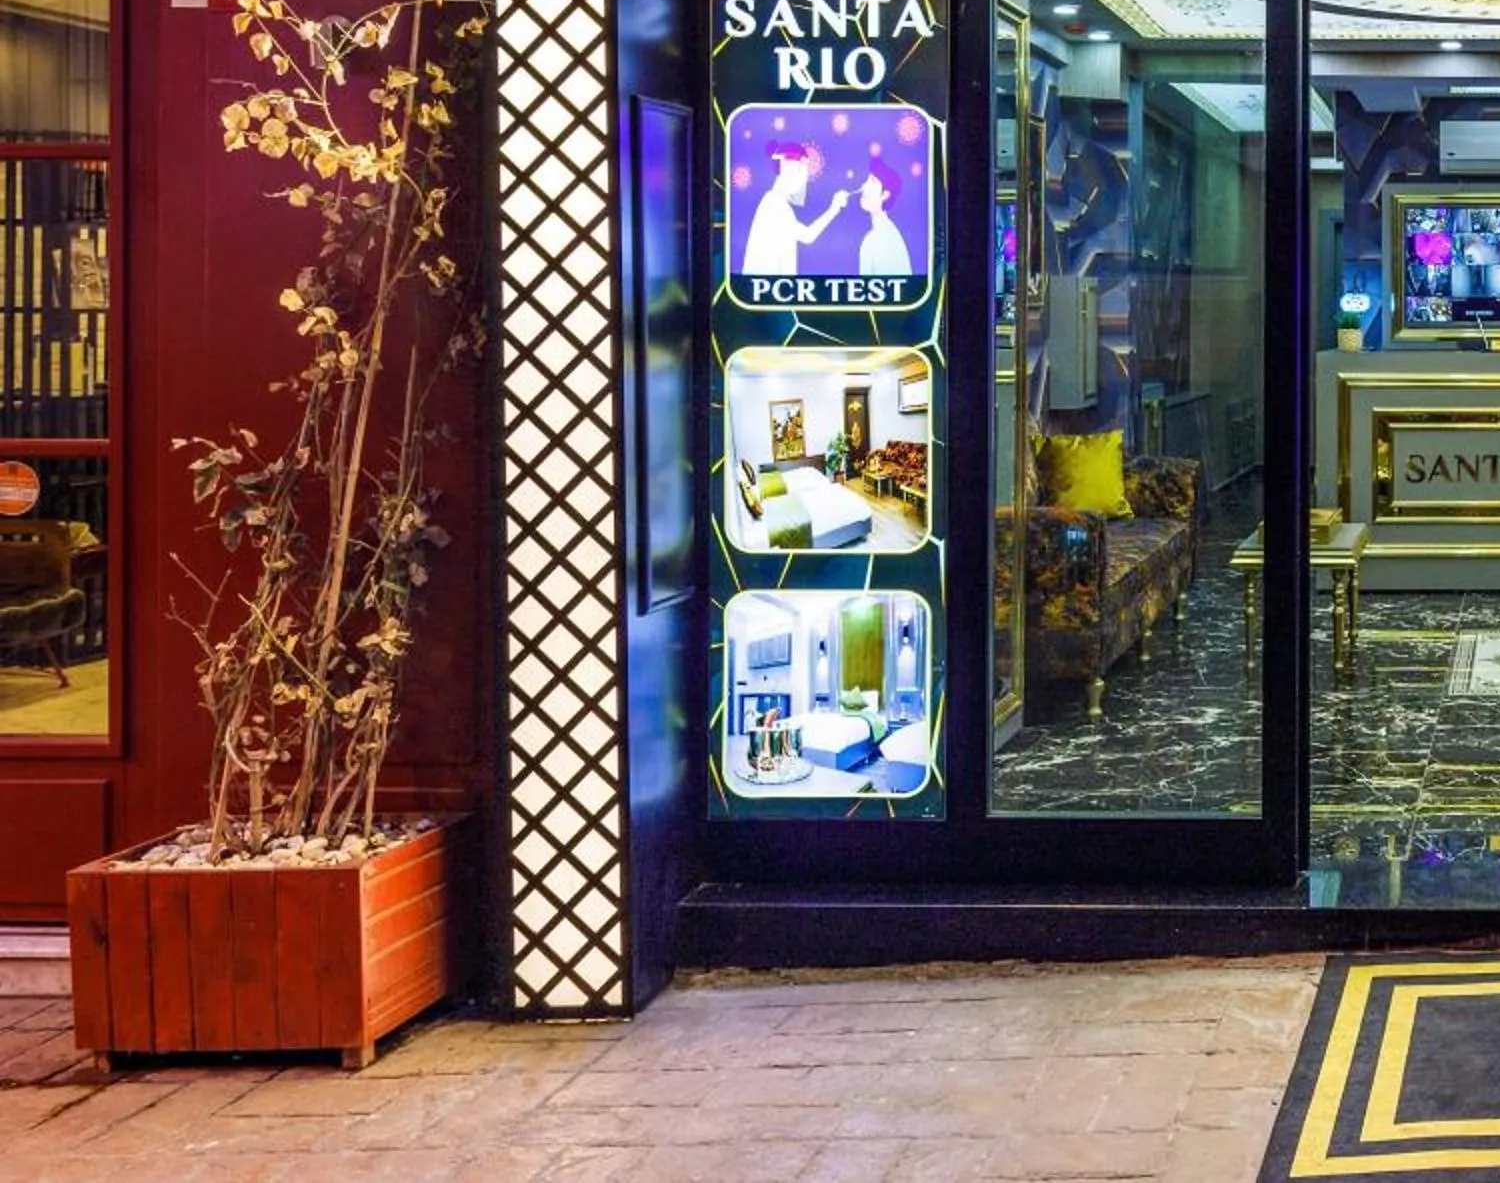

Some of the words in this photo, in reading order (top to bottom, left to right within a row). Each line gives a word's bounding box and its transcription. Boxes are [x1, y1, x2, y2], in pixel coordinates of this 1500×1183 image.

[774, 45, 888, 91] RIO
[751, 277, 817, 303] PCR
[825, 277, 908, 303] TEST
